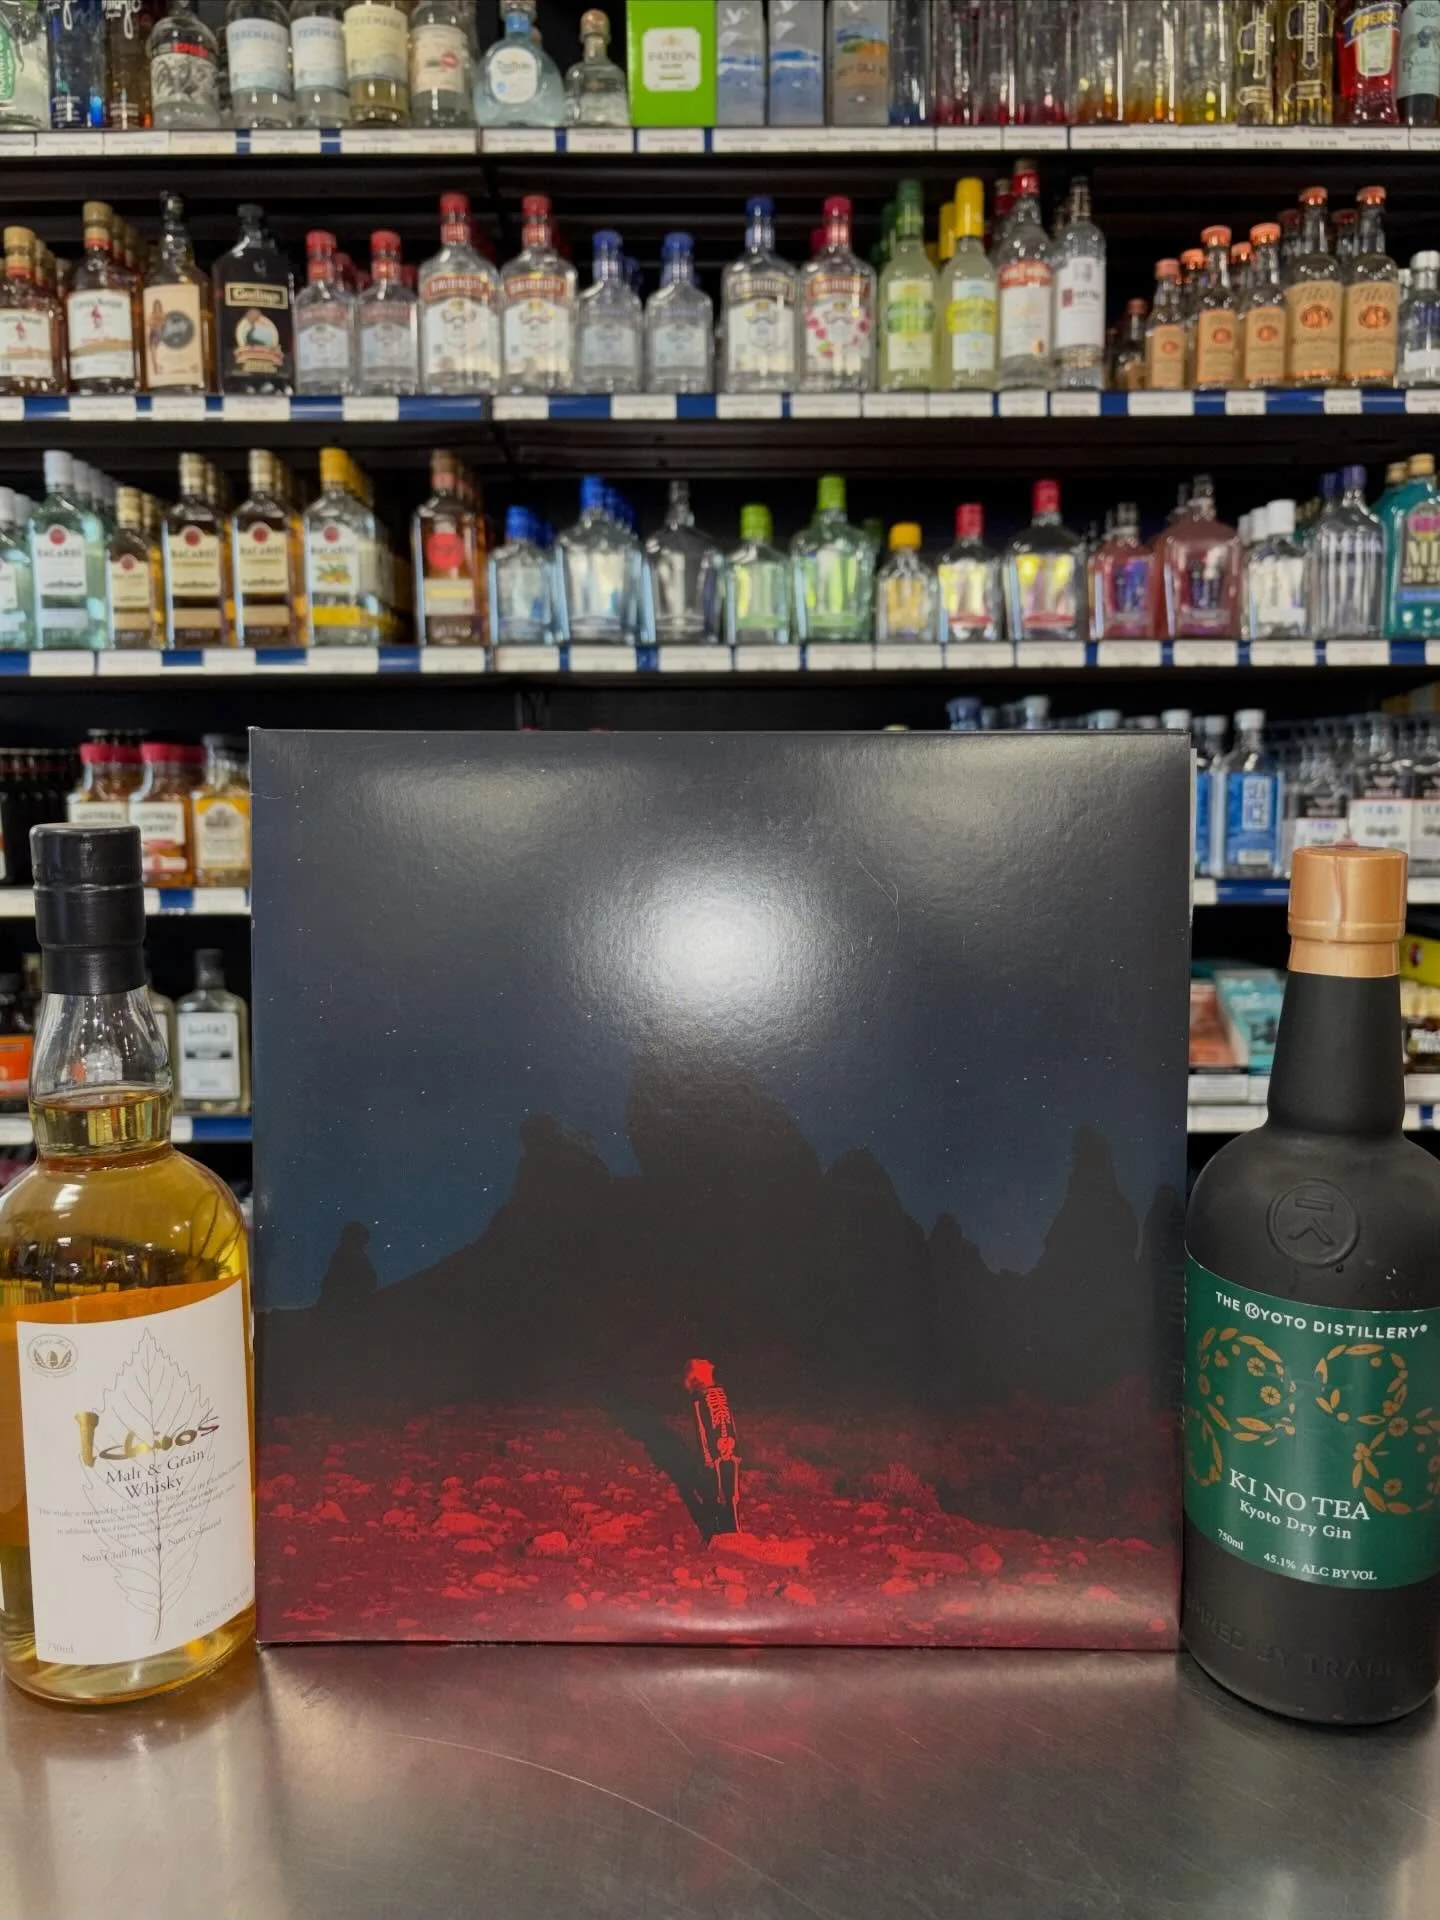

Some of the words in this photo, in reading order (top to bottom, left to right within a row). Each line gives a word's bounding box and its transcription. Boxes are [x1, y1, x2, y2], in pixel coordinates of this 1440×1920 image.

[1215, 1291, 1241, 1312] THE
[105, 1467, 141, 1485] Malt
[147, 1463, 162, 1477] &
[166, 1449, 206, 1471] Grain
[124, 1475, 185, 1500] Whisky
[1229, 1468, 1257, 1497] KI
[1263, 1483, 1307, 1512] NO
[1311, 1496, 1371, 1521] TEA
[1239, 1498, 1281, 1526] Kyoto
[1286, 1516, 1318, 1538] Dry
[1322, 1524, 1352, 1540] Gin
[1217, 1528, 1245, 1551] 750ml
[1263, 1552, 1297, 1570] 45.1%
[1301, 1563, 1330, 1577] ALC
[1332, 1567, 1350, 1580] BY
